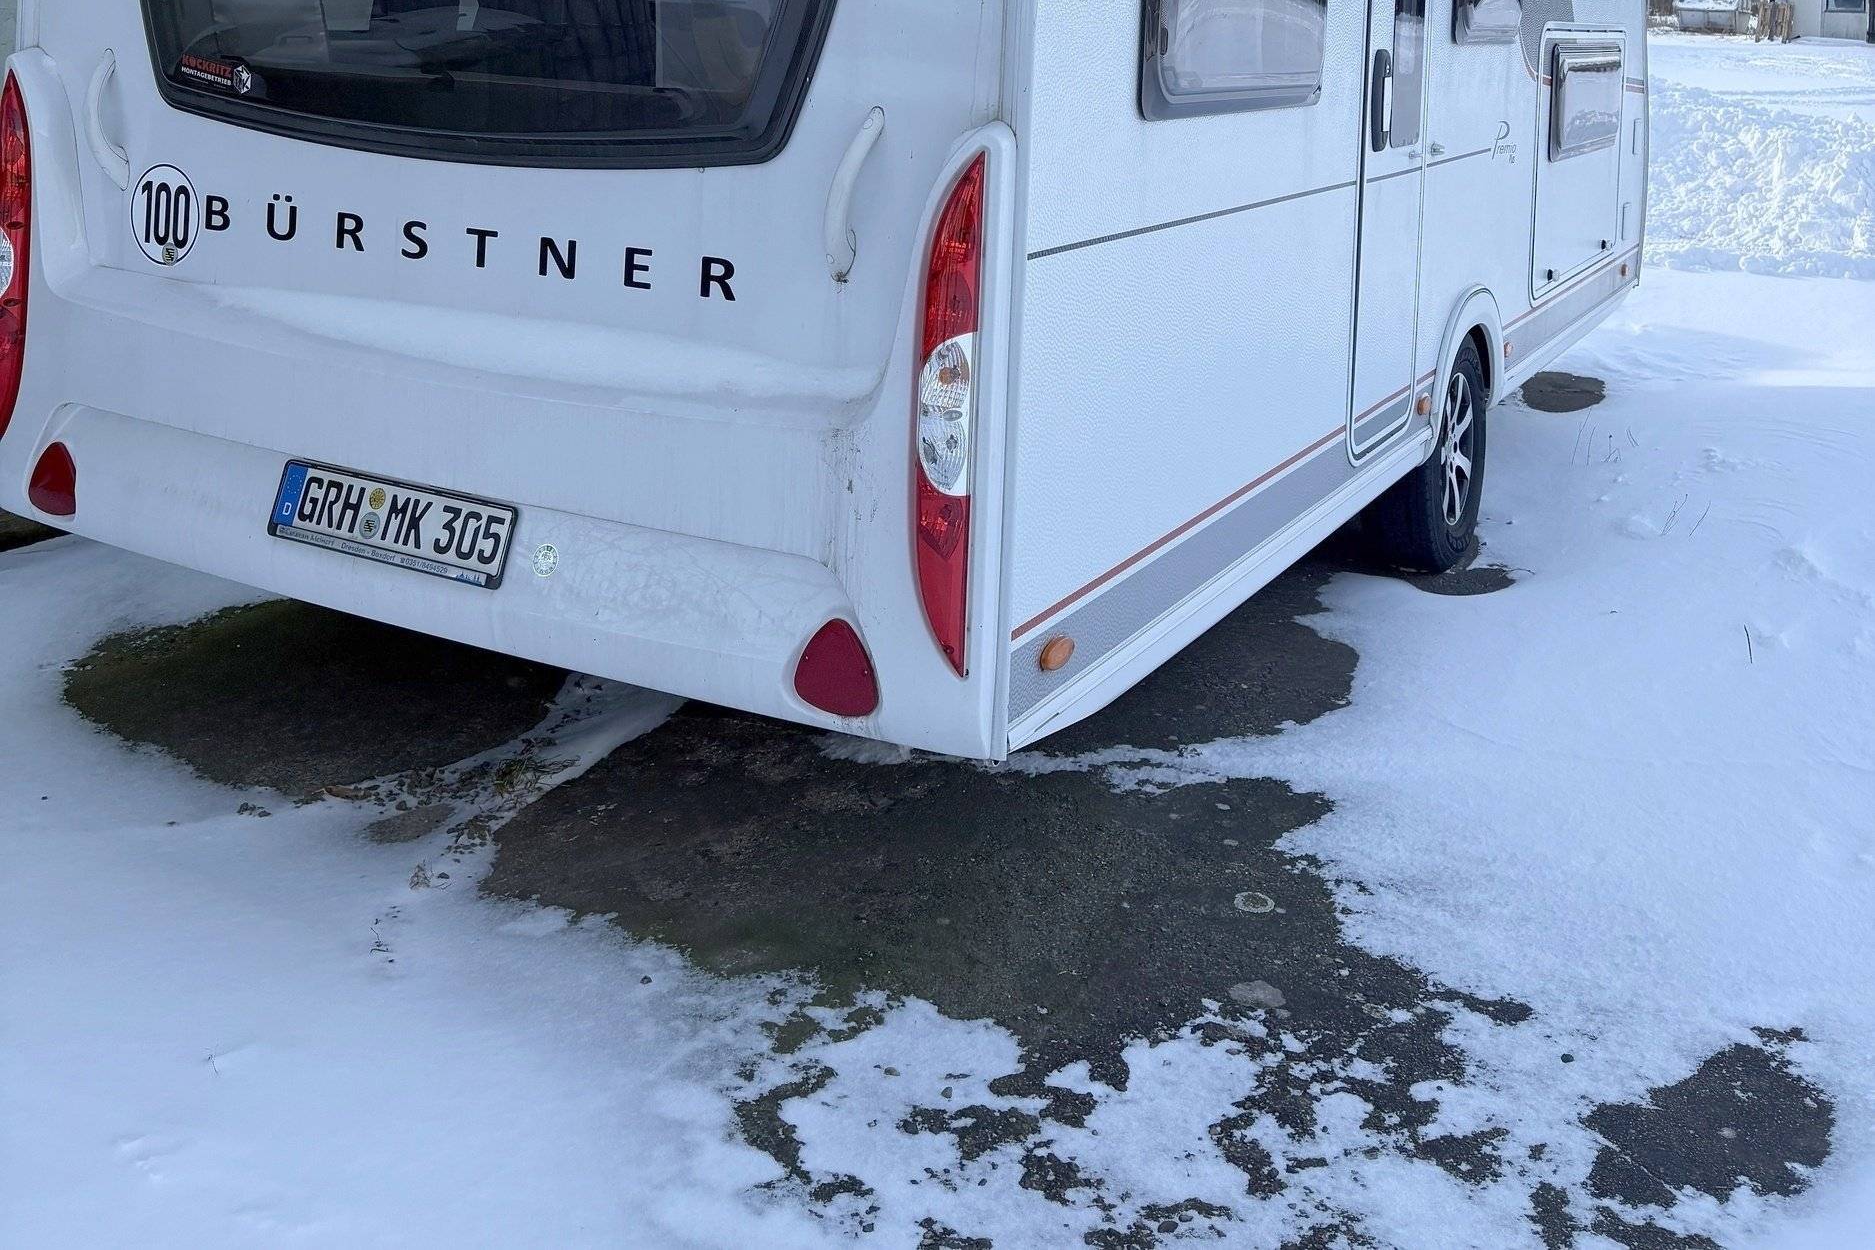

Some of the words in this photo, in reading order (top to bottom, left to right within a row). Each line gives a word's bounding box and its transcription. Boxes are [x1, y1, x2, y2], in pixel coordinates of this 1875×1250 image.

[181, 66, 232, 86] MONTAGEBETRIEB
[141, 180, 191, 250] 100
[204, 193, 737, 302] BÜRSTNER
[282, 502, 292, 516] D
[297, 476, 366, 534] GRH
[380, 494, 433, 550] MK
[433, 505, 506, 565] 305
